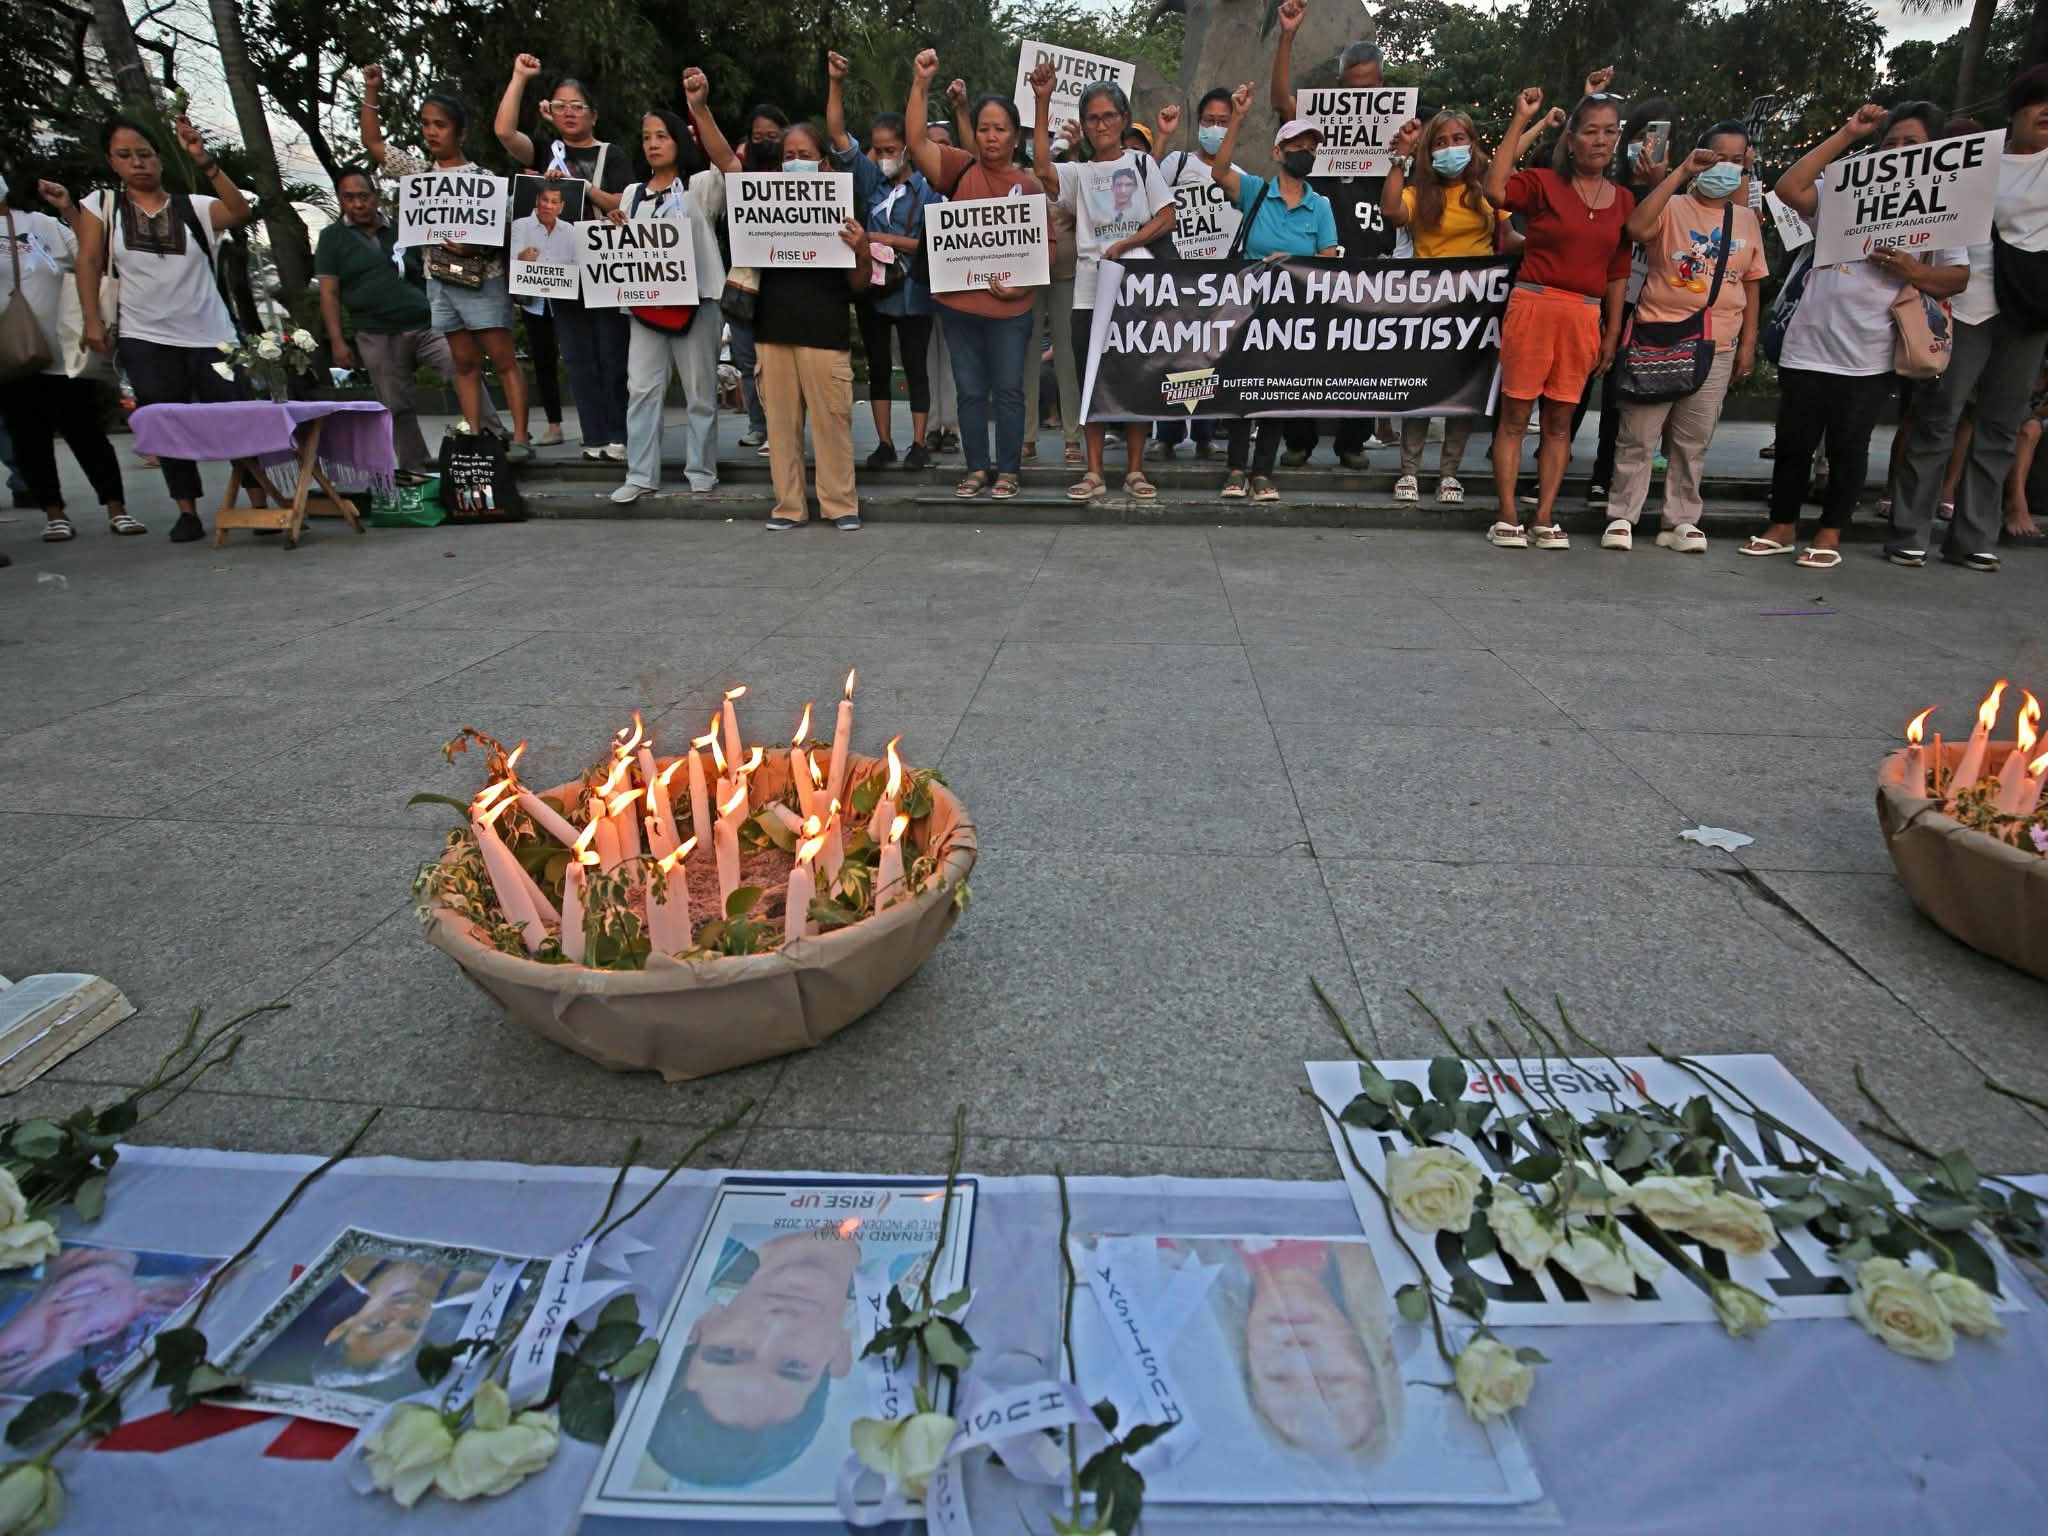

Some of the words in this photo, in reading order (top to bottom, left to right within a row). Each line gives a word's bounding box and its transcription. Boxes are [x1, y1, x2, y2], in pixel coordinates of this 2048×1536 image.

[1305, 91, 1407, 116] JUSTICE
[1320, 116, 1363, 124] HELPS
[1322, 125, 1383, 147] HEAL
[1335, 161, 1357, 169] RISE
[1358, 161, 1373, 169] UP
[1834, 136, 1986, 192] JUSTICE
[409, 176, 496, 199] STAND
[742, 180, 836, 201] DUTERTE
[1853, 178, 1916, 198] HELPS
[1932, 172, 1958, 185] US
[1173, 183, 1225, 210] STIC
[1855, 185, 1947, 225] HEAL
[404, 207, 496, 227] VICTIMS!
[734, 206, 848, 224] PANAGUTIN!
[940, 203, 1031, 229] DUTERTE
[1178, 207, 1201, 218] LPS
[1209, 204, 1223, 213] US
[432, 230, 453, 238] RISE
[454, 230, 467, 238] UP
[1844, 222, 1896, 237] #DUTERTE
[1895, 213, 1959, 229] PANAGUTIN
[587, 223, 680, 250] STAND
[933, 226, 1041, 252] PANAGUTIN!
[1175, 238, 1194, 247] ERTE
[1873, 236, 1907, 248] RISE
[1909, 232, 1931, 245] UP
[600, 251, 634, 260] WITH
[644, 250, 669, 259] THE
[777, 250, 801, 261] RISE
[802, 250, 817, 261] UP
[1184, 248, 1204, 259] RISE
[1204, 246, 1217, 256] UP
[526, 264, 565, 277] DUTERTE
[586, 260, 688, 284] VICTIMS!
[973, 272, 997, 283] RISE
[997, 271, 1012, 281] UP
[516, 274, 573, 288] PANAGUTIN!
[1306, 269, 1510, 304] HANGGANG
[623, 290, 646, 299] RISE
[646, 289, 661, 299] UP
[1242, 317, 1317, 351] ANG
[1326, 316, 1501, 351] HUSTISYA
[1161, 374, 1219, 392] DUTERTE
[1223, 378, 1265, 387] DUTERTE
[1266, 377, 1323, 387] PANAGUTIN
[1325, 377, 1377, 387] CAMPAIGN
[1379, 377, 1428, 387] NETWORK
[1167, 385, 1215, 400] PANAGUTIN!
[1239, 391, 1259, 400] FOR
[1260, 391, 1300, 400] JUSTICE
[1301, 391, 1324, 400] AND
[1325, 391, 1410, 400] ACCOUNTABILITY
[1470, 1074, 1523, 1094] UP
[1523, 1074, 1621, 1093] RISE
[789, 1195, 820, 1208] UP
[823, 1195, 875, 1208] RISE
[772, 1218, 801, 1229] 2018
[920, 1218, 939, 1230] ATE
[1097, 1267, 1183, 1425] HUSTISYA
